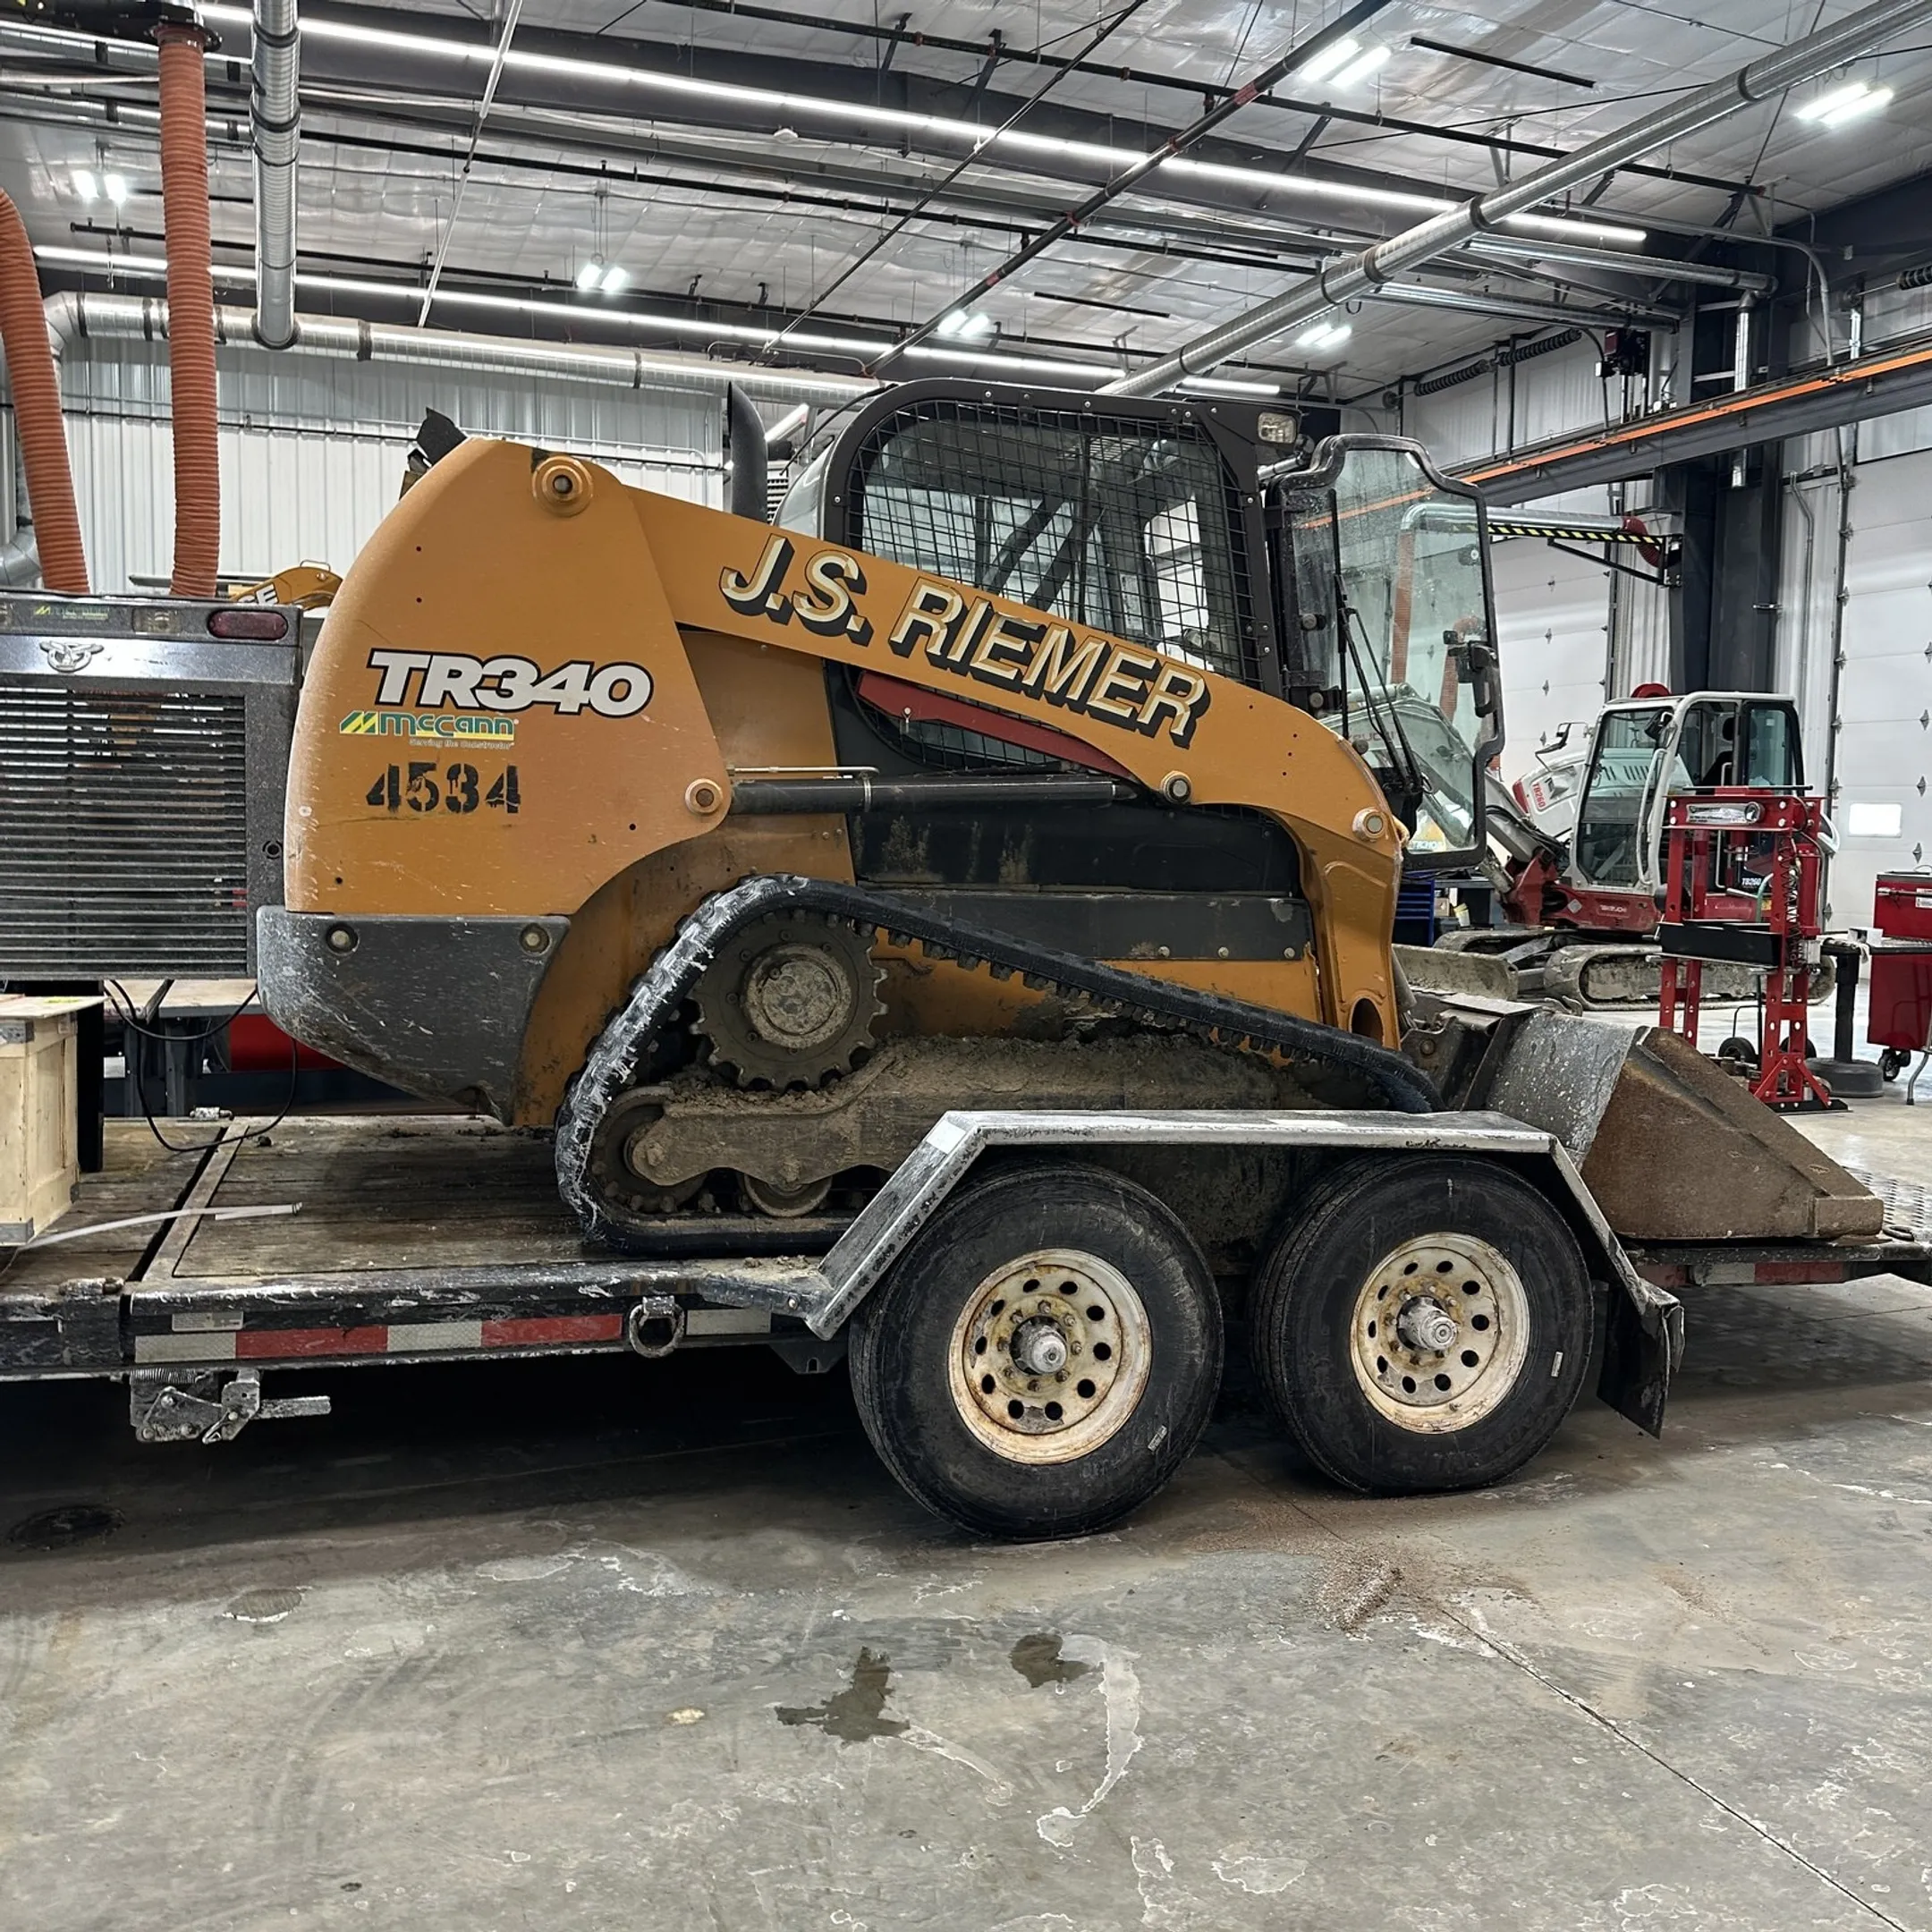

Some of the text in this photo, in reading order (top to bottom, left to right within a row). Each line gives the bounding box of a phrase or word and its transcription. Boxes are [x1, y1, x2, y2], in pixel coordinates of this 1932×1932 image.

[718, 533, 1213, 750] J.S. RIEMER
[367, 648, 655, 718] TR340
[365, 762, 521, 814] 4534
